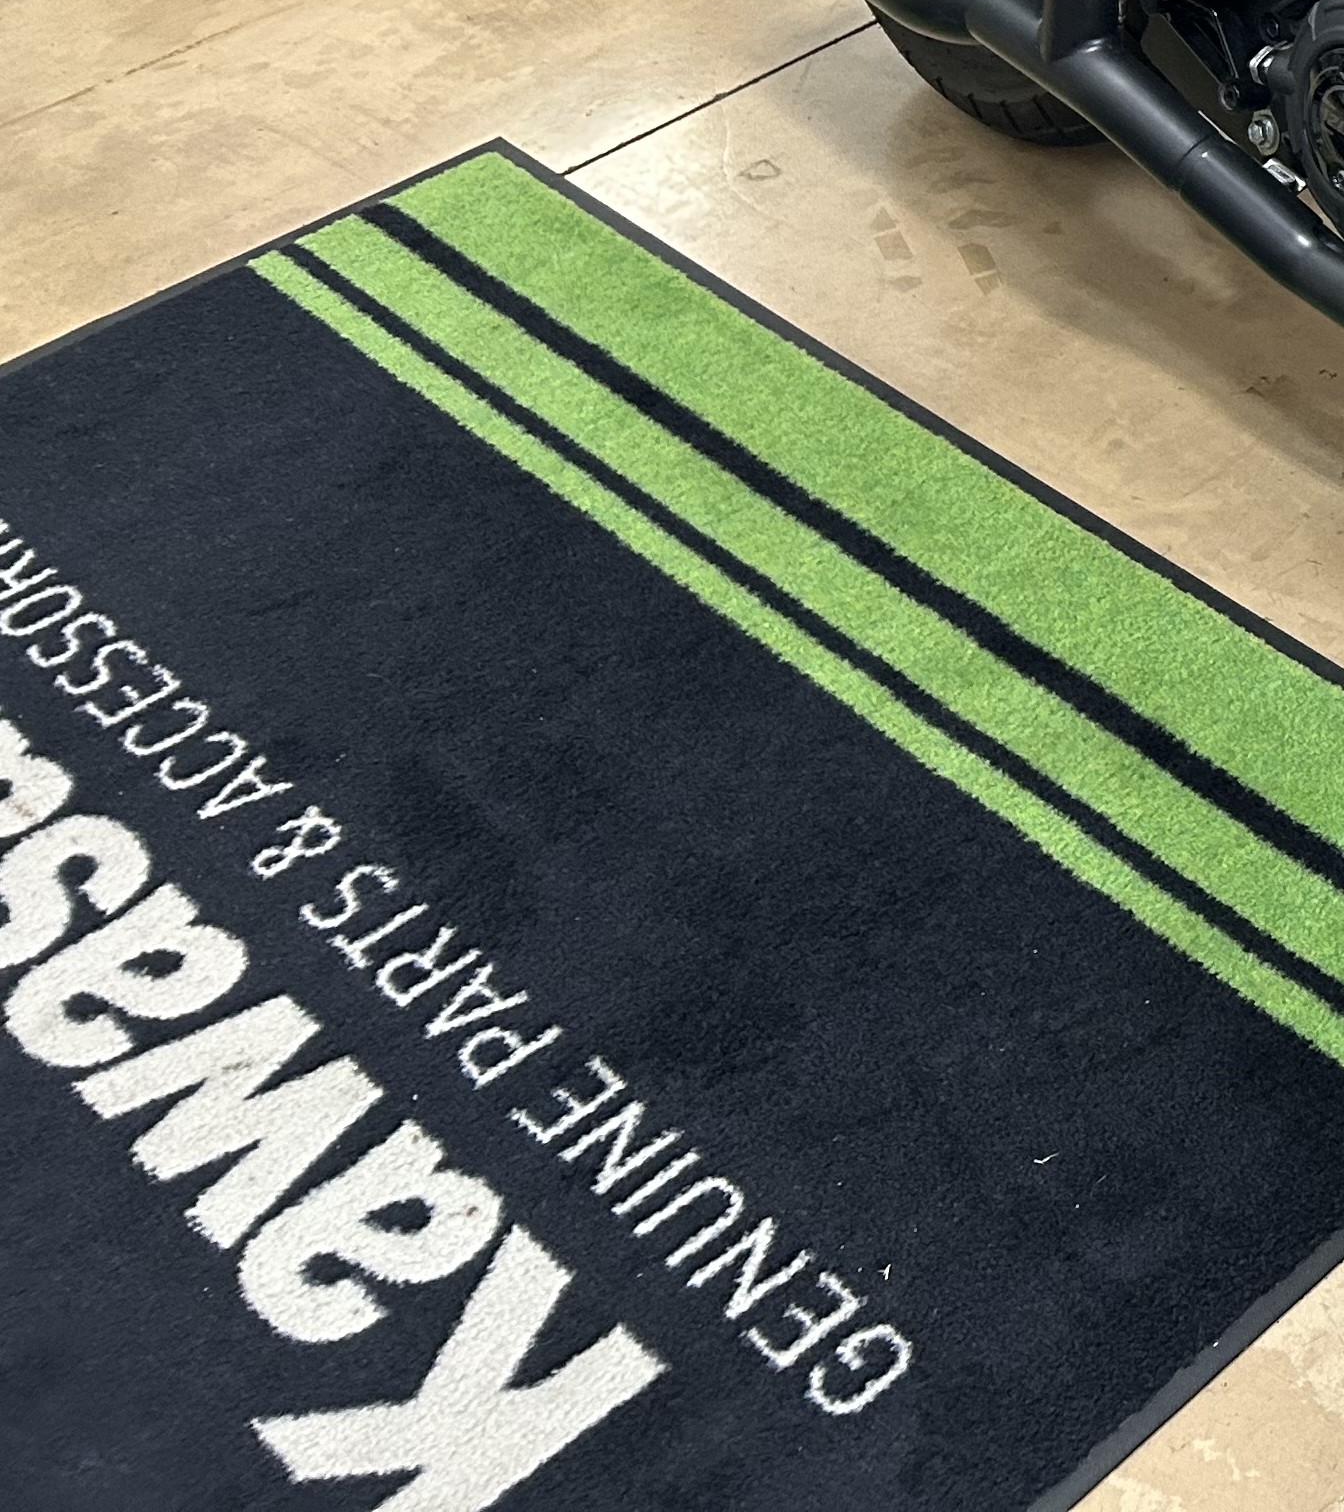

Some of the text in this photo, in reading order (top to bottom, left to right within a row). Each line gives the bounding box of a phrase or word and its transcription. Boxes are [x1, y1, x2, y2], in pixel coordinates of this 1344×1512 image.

[251, 805, 343, 879] &
[298, 862, 564, 1091] PARTS
[511, 1057, 914, 1416] GENUINE
